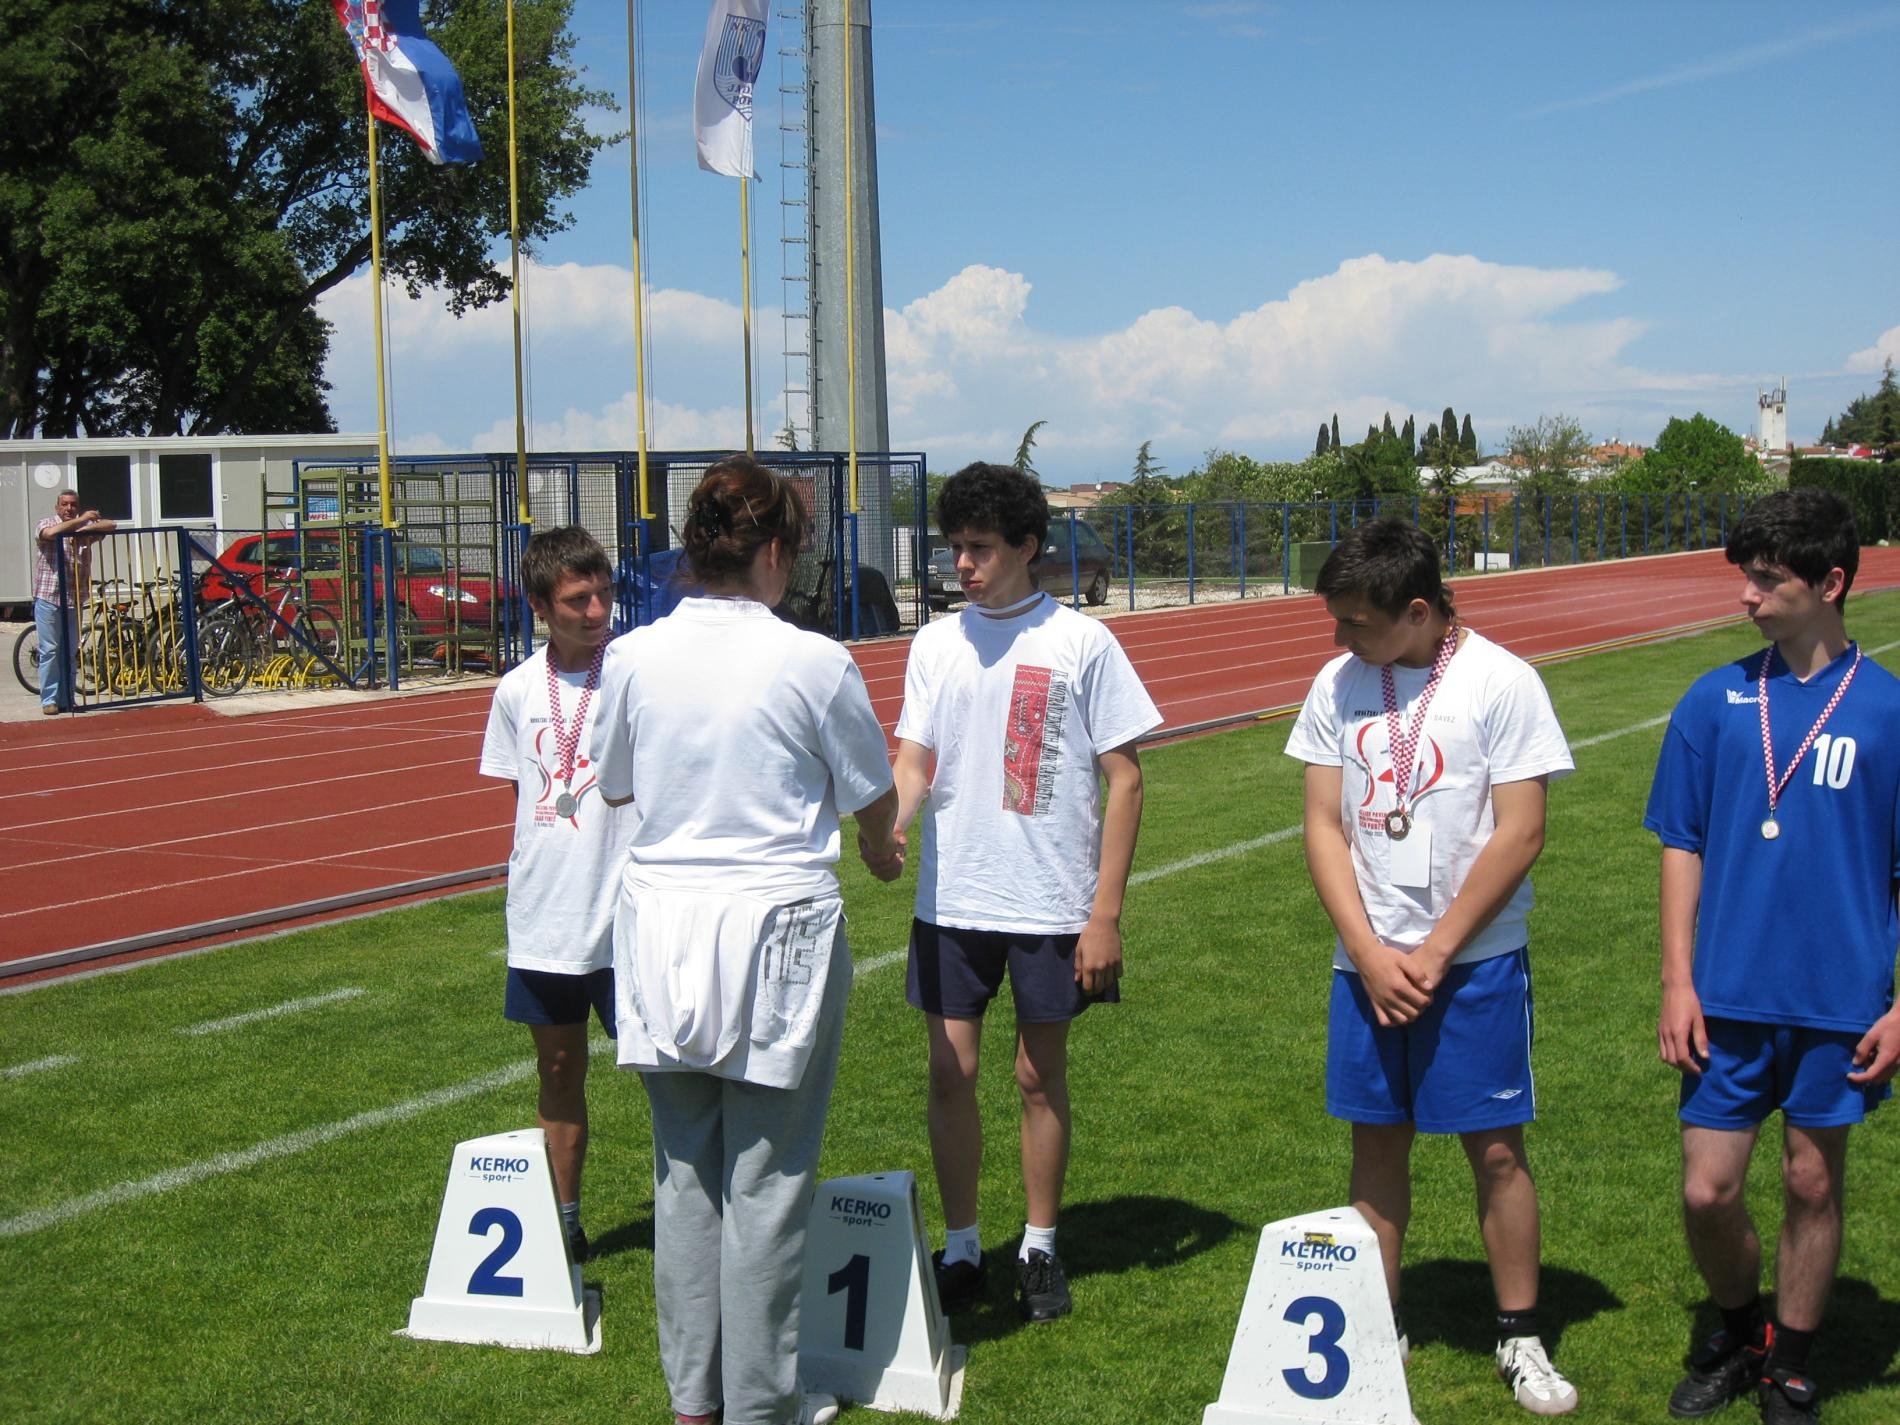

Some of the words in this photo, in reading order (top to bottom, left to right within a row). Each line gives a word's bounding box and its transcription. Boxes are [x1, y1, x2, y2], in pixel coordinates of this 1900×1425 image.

[727, 84, 751, 94] JAD
[733, 96, 752, 104] POR
[1813, 733, 1857, 789] 10
[470, 1156, 529, 1173] KERKO
[482, 1173, 512, 1183] sport
[831, 1196, 891, 1219] KERKO
[842, 1215, 872, 1227] sport
[467, 1207, 523, 1297] 2
[1281, 1240, 1357, 1262] KERKO
[1296, 1261, 1334, 1272] sport
[827, 1254, 869, 1351] 1
[1282, 1296, 1350, 1400] 3
